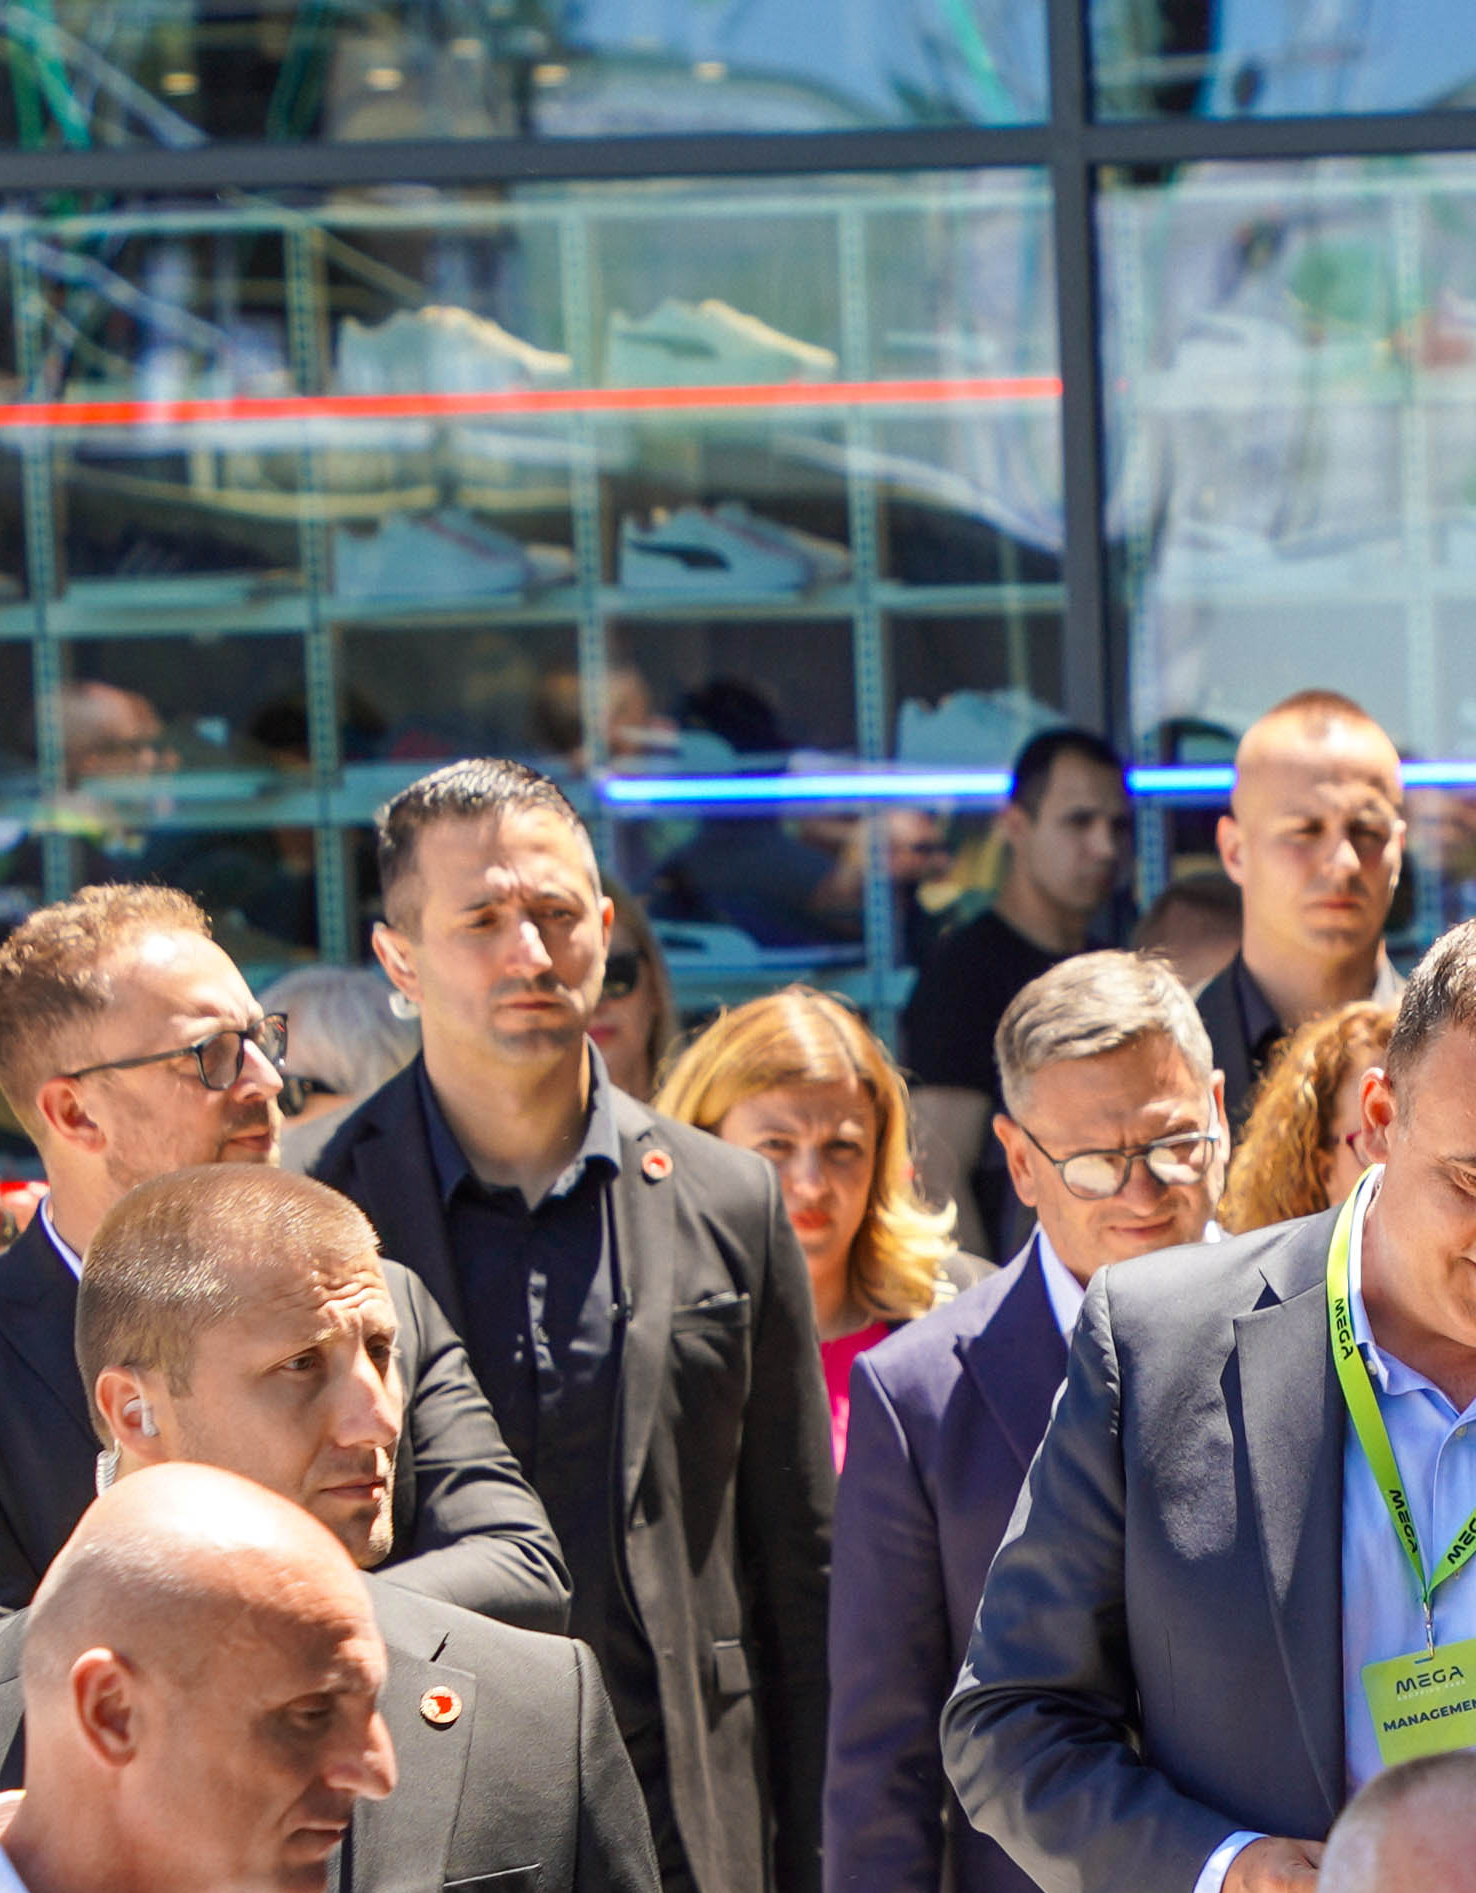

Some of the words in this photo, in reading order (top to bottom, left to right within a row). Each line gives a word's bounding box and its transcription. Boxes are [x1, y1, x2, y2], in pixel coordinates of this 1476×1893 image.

[1334, 1297, 1354, 1360] MEGA
[1388, 1489, 1419, 1554] MEGA
[1395, 1665, 1465, 1695] MEGA
